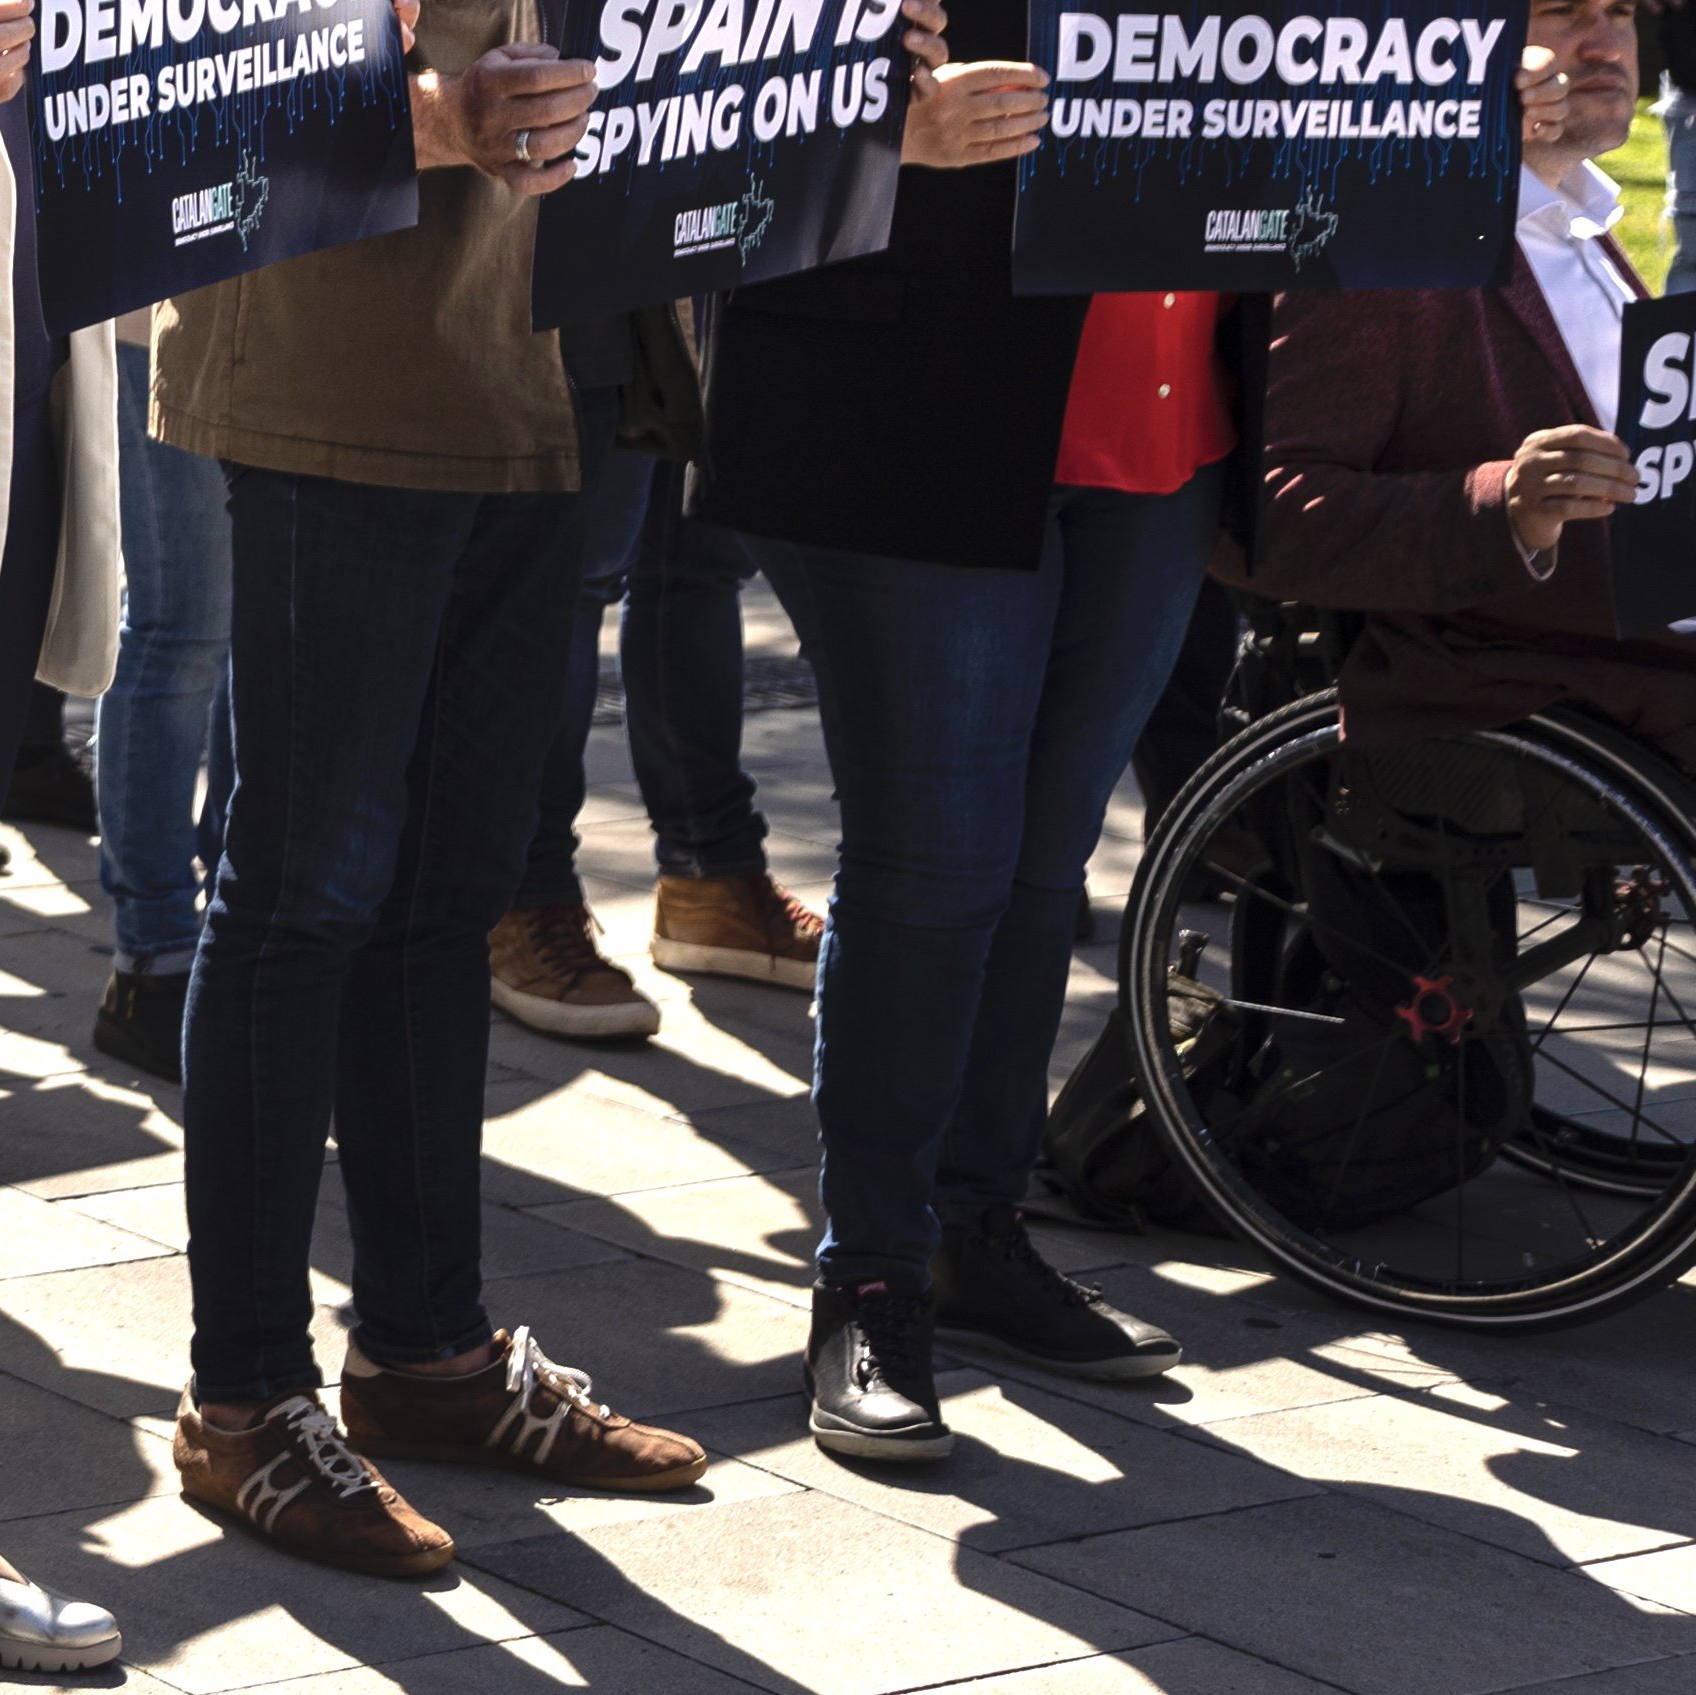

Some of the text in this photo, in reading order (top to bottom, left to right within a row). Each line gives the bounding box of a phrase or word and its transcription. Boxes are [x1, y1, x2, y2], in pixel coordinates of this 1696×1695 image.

[1055, 11, 1508, 87] DEMOCRACY
[43, 17, 366, 142] UNDER SURVEILLANCE
[572, 56, 891, 180] SPYING ON US
[1050, 97, 1484, 139] UNDER SURVEILLANCE
[172, 181, 234, 235] CATALANGATE
[674, 201, 738, 247] CATALANGATE
[1204, 209, 1290, 242] CATALANGATE
